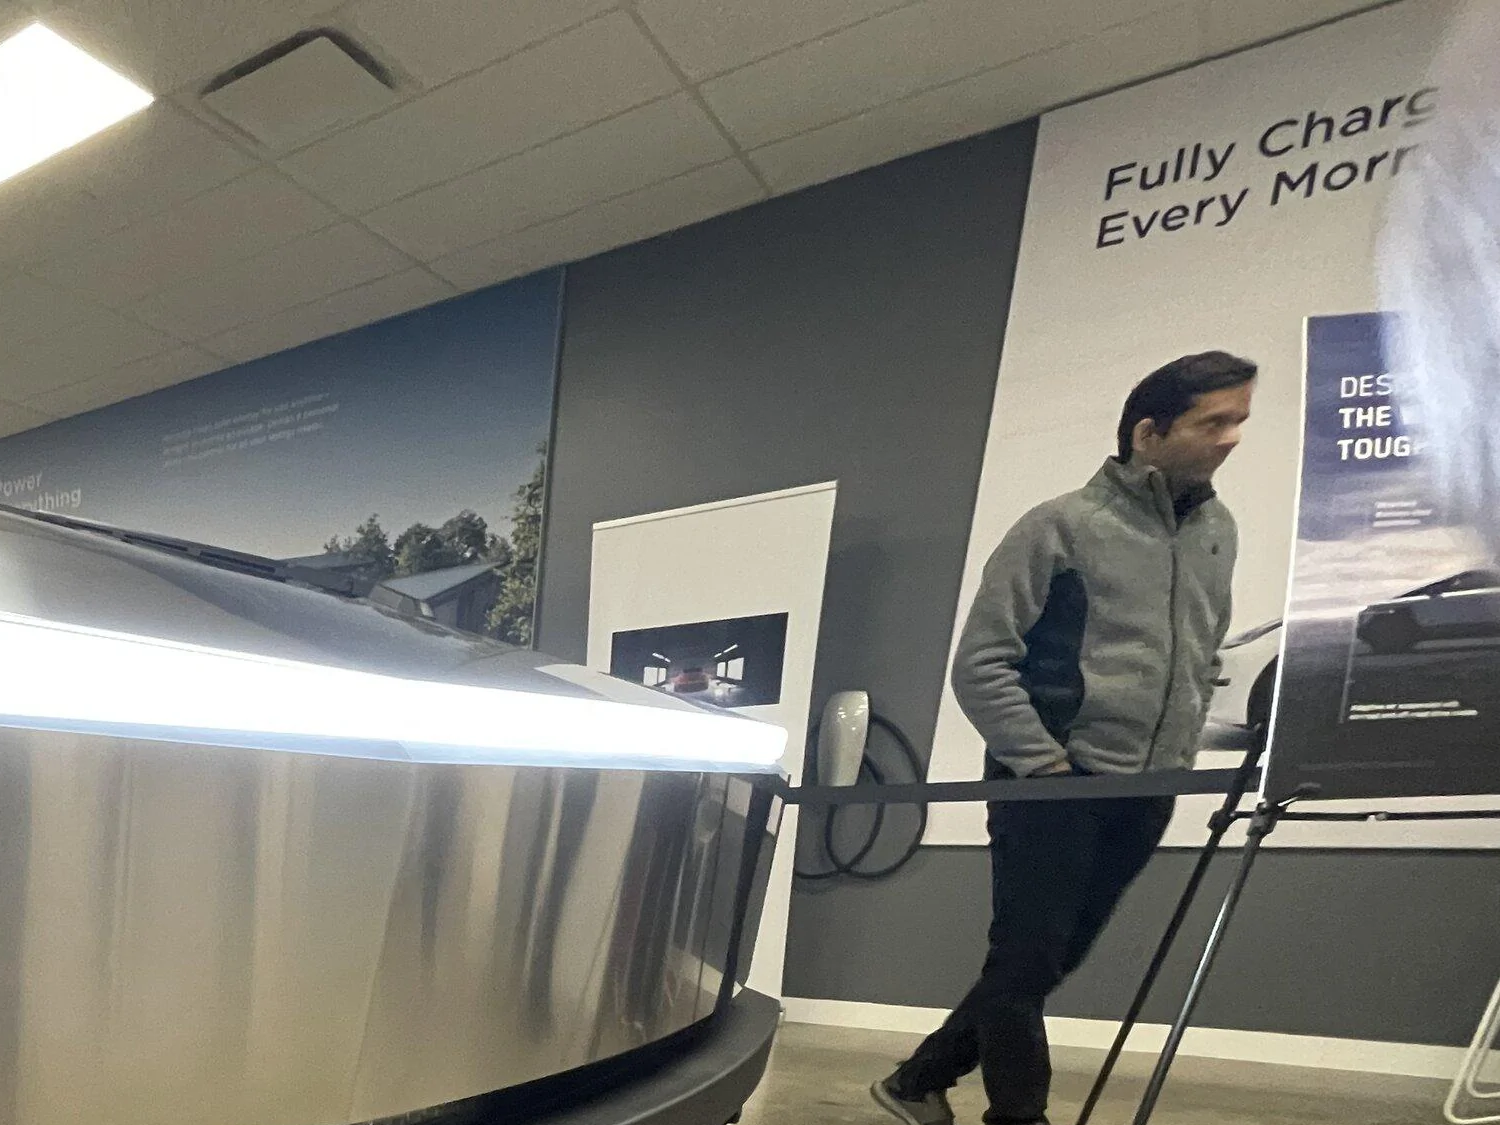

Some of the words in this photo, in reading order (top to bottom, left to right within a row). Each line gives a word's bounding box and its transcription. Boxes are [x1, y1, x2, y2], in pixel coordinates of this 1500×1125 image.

[1104, 142, 1237, 201] Fully
[1096, 187, 1249, 250] Every
[1338, 405, 1392, 429] THE
